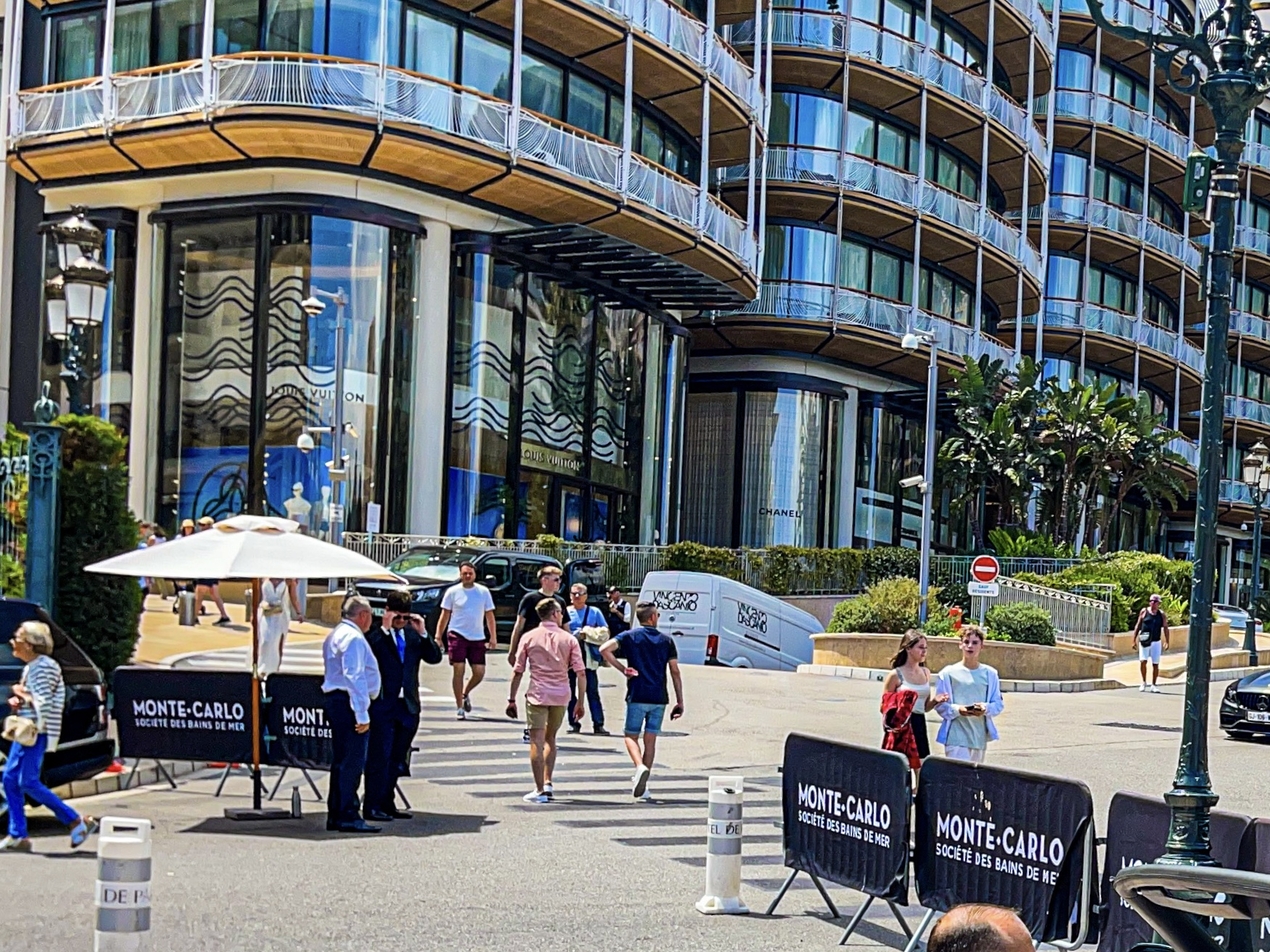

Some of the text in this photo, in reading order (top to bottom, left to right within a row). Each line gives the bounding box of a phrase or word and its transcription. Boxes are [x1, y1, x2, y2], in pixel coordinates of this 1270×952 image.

[310, 388, 365, 403] VUION
[758, 507, 801, 519] CHANEL
[170, 718, 187, 729] DES
[187, 719, 213, 730] BAINS
[215, 721, 227, 731] DE
[228, 722, 245, 732] MER
[317, 728, 333, 739] DES
[826, 818, 840, 833] DES
[840, 822, 862, 840] BAINS
[863, 828, 874, 843] DE
[874, 832, 891, 848] MER
[974, 852, 992, 869] DES
[995, 856, 1024, 878] BAINS
[1026, 865, 1040, 882] DE
[104, 888, 128, 904] DE
